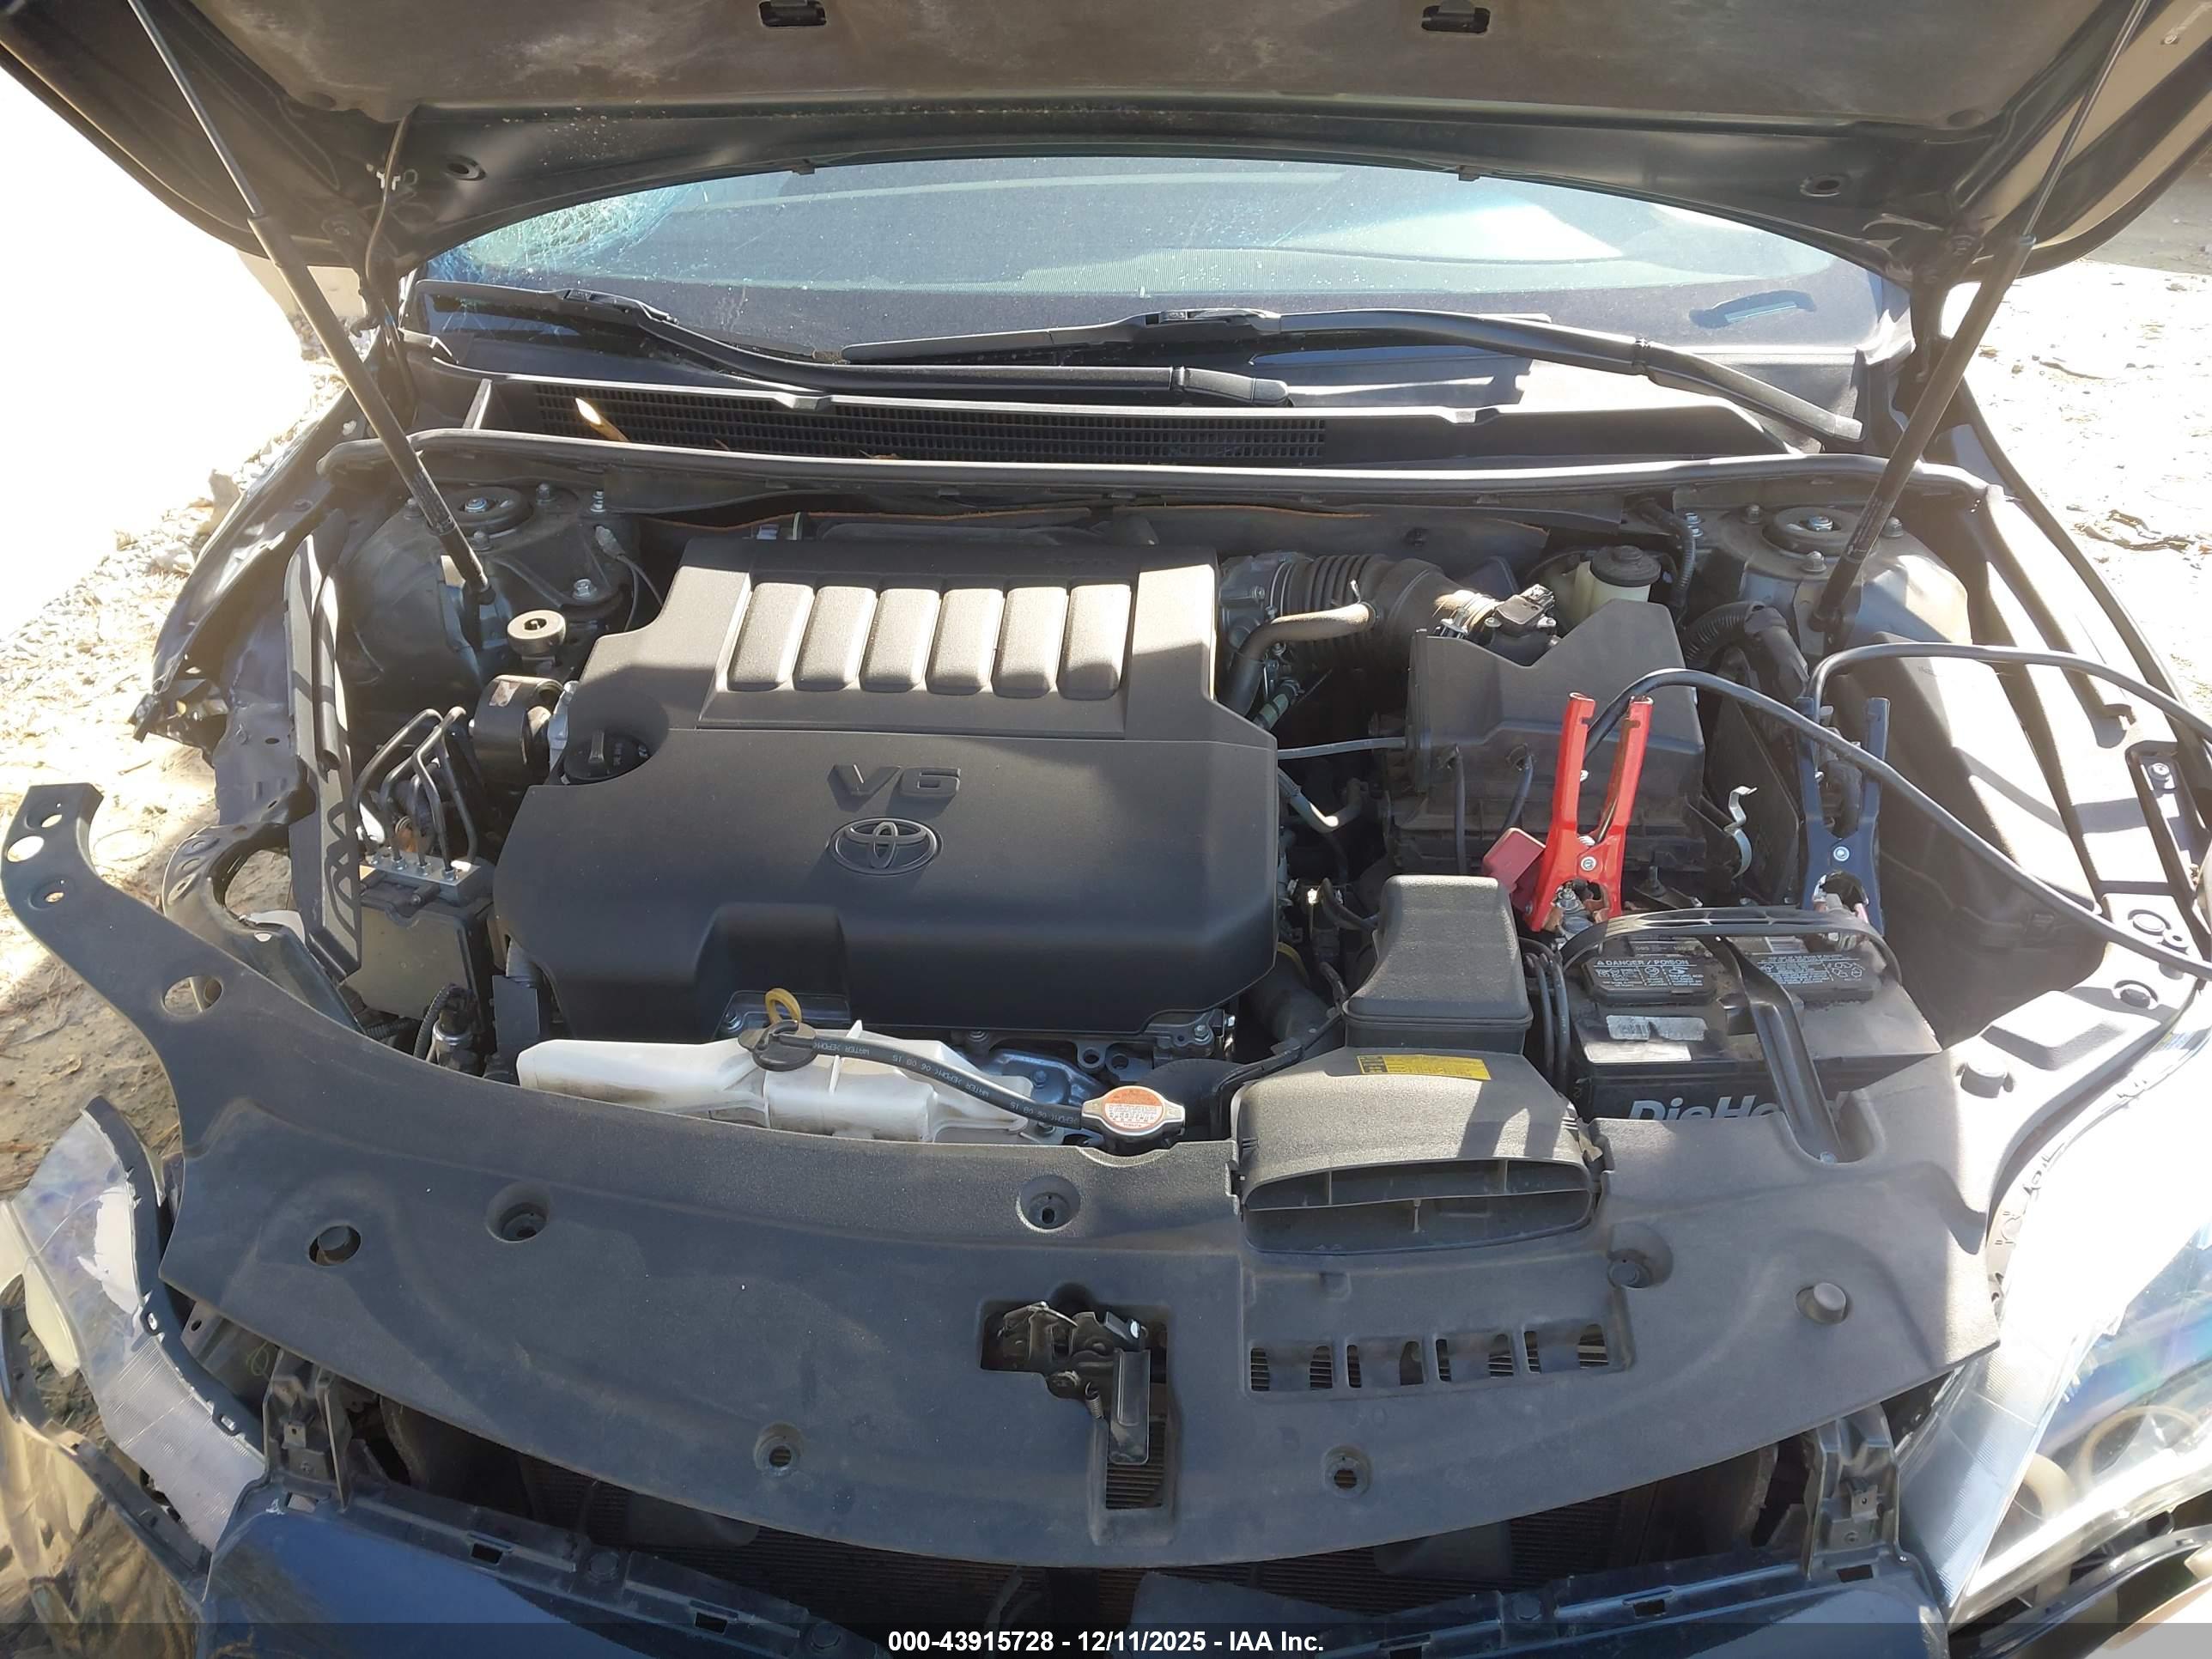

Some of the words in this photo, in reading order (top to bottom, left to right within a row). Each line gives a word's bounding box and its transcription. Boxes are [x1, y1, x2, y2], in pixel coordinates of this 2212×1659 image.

[827, 763, 963, 799] V6
[844, 1045, 869, 1055] WATER
[966, 1082, 989, 1097] WATER
